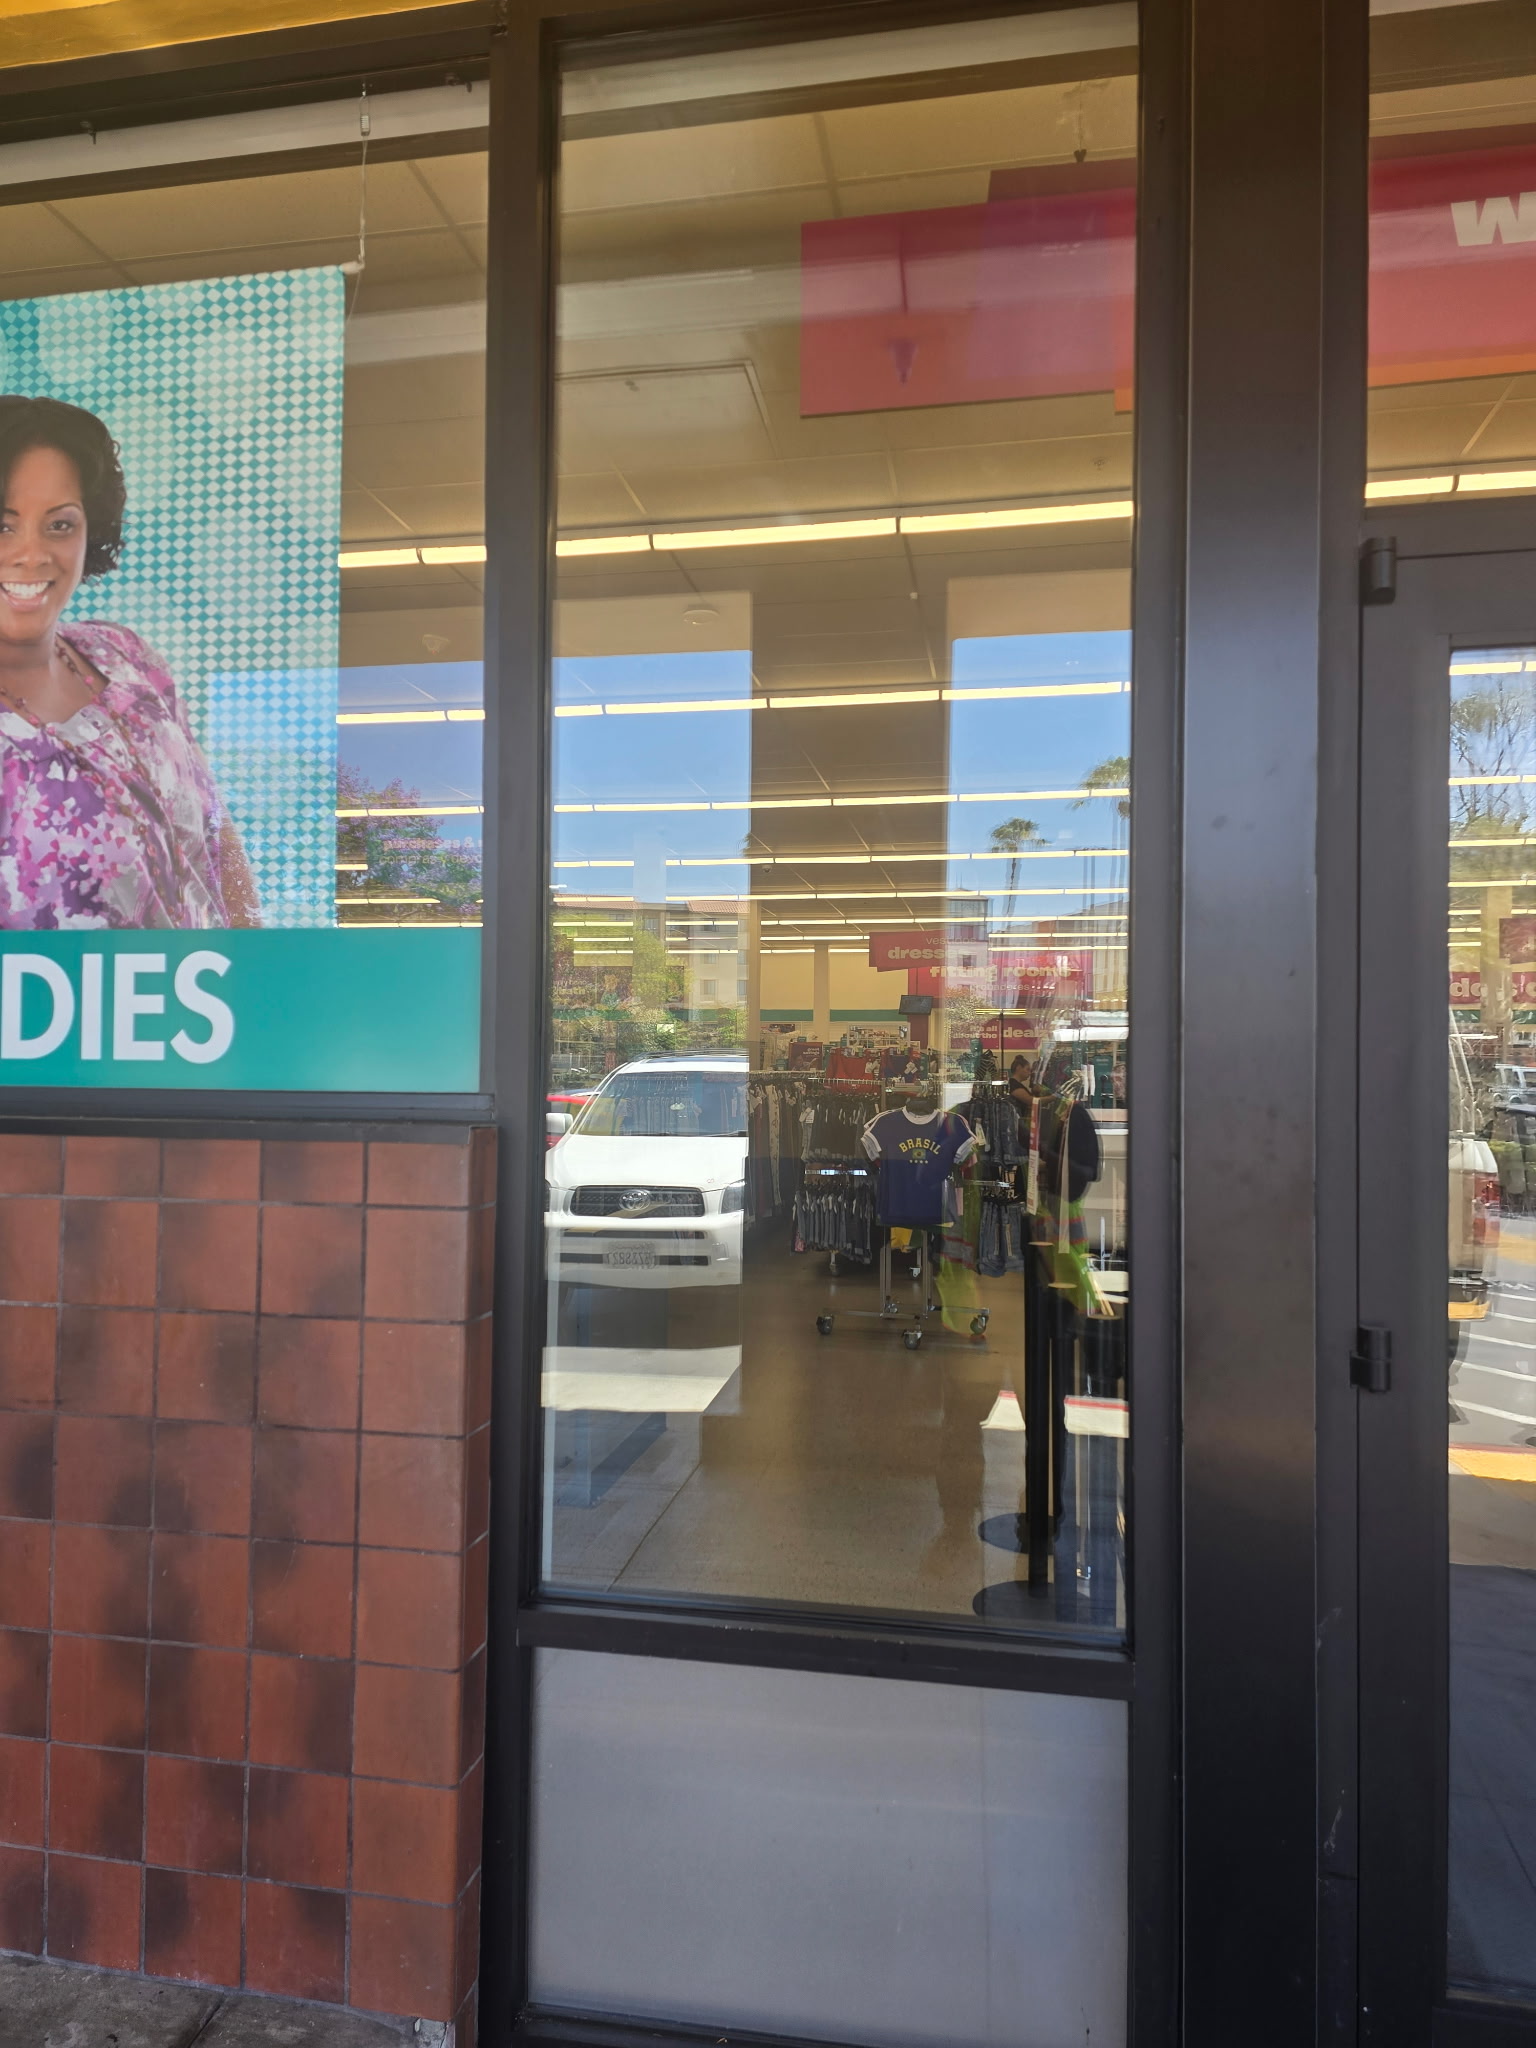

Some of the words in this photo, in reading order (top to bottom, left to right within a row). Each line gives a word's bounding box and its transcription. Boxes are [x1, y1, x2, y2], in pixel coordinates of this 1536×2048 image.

[929, 965, 998, 983] fitting
[1004, 966, 1072, 978] rooms
[0, 950, 235, 1064] DIES
[899, 1137, 941, 1155] BRASIL
